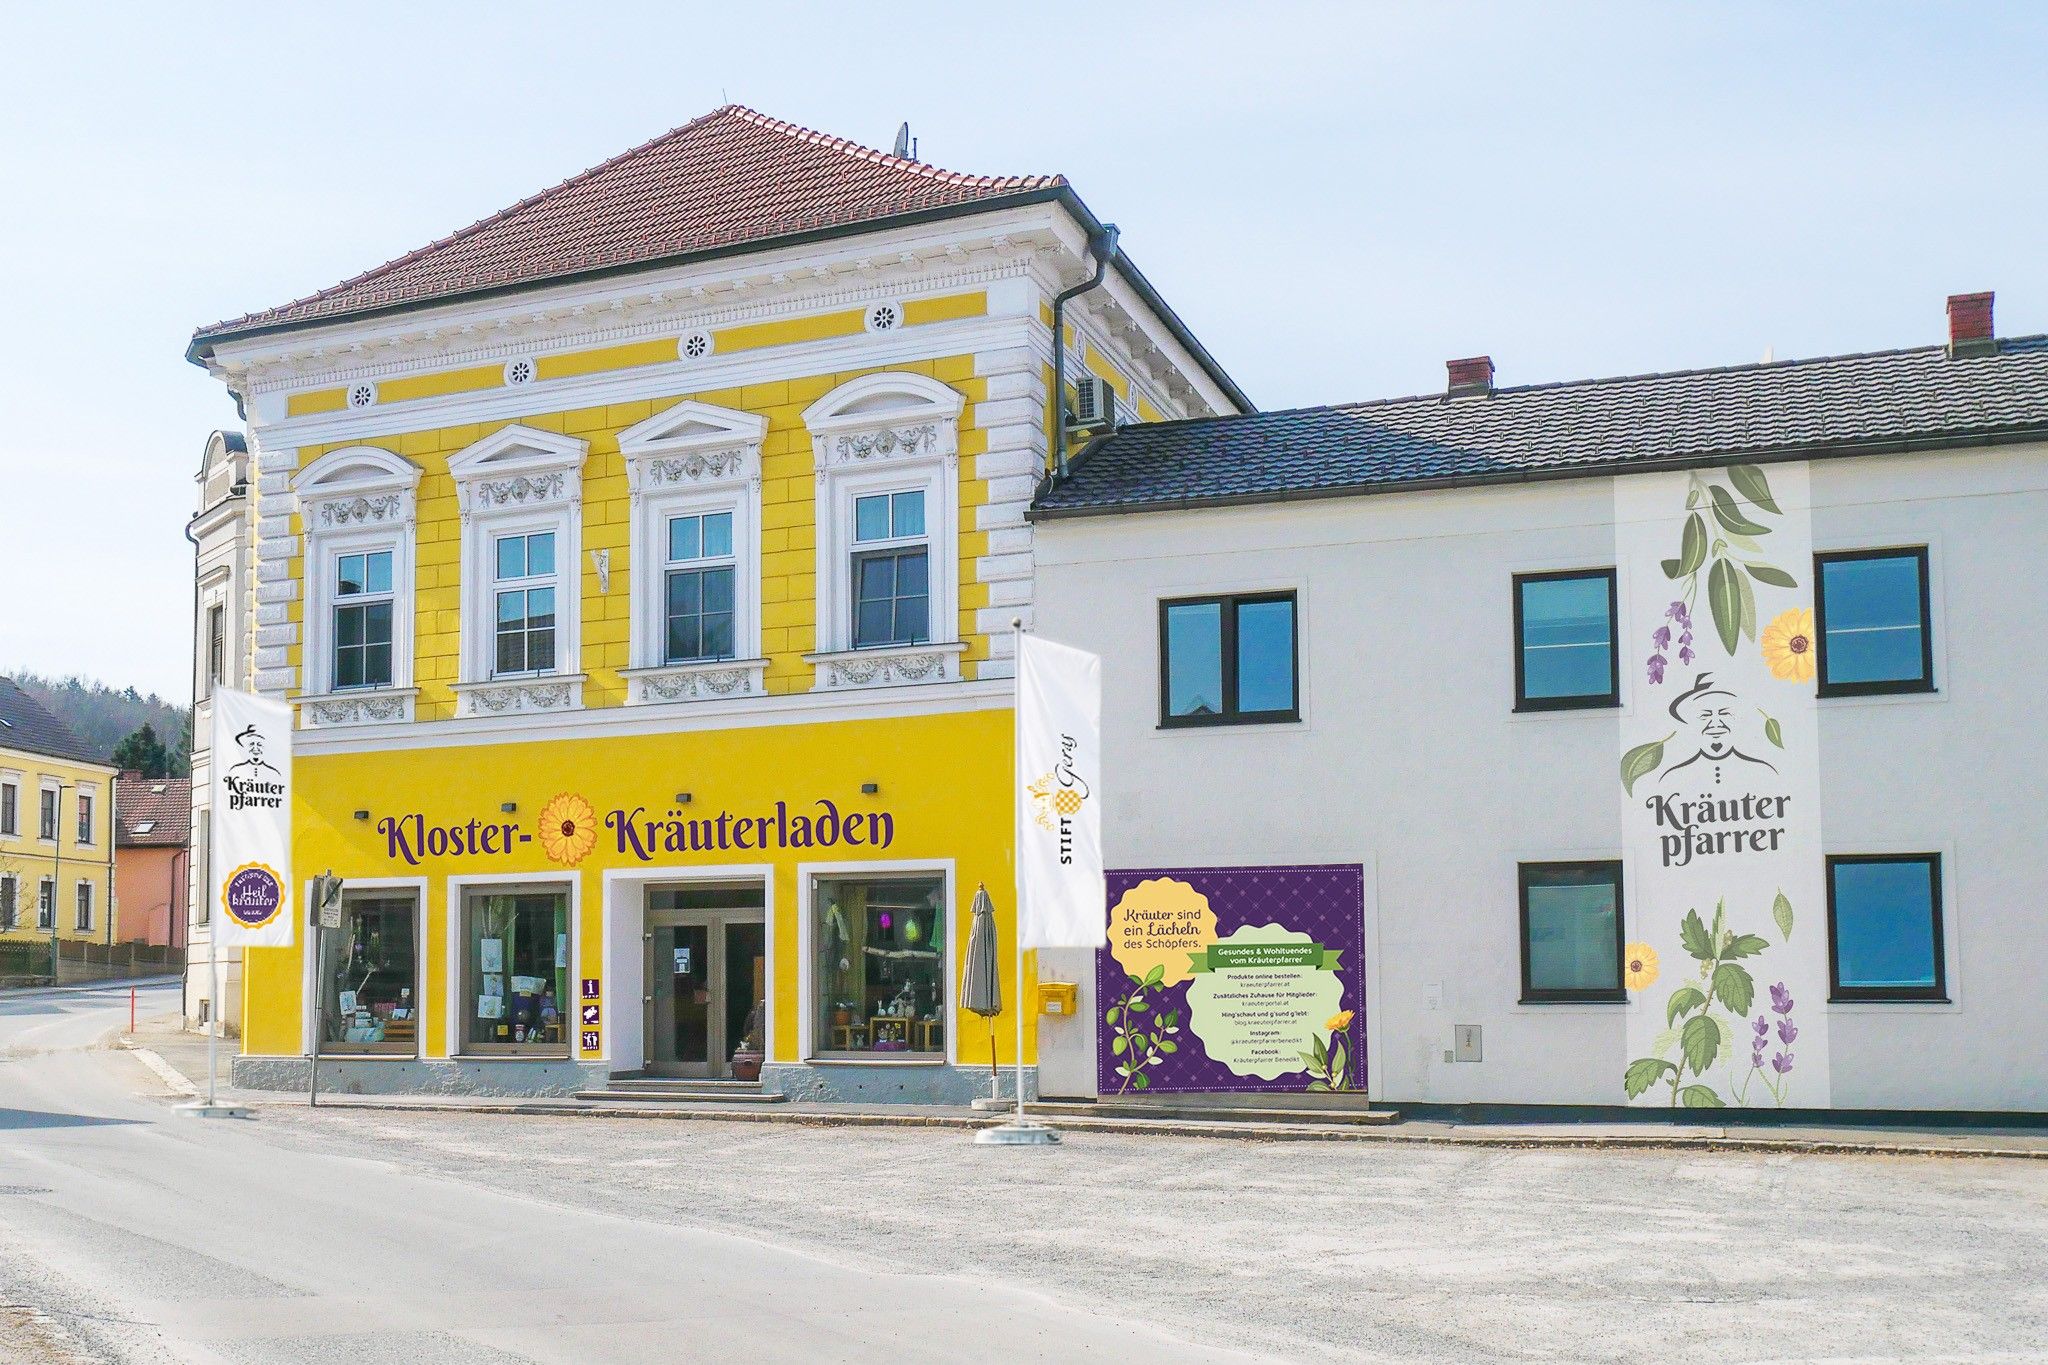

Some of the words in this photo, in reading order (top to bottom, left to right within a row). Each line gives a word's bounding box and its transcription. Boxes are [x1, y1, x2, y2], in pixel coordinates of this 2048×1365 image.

[223, 776, 285, 795] Kräuter
[229, 791, 282, 811] pfarrer
[1645, 792, 1791, 831] Kräuter
[377, 813, 533, 866] Kloster-
[604, 799, 895, 862] Kräuterladen
[1060, 817, 1072, 865] STIFT
[1660, 824, 1785, 867] pfarrer
[1123, 908, 1174, 923] Kräuter
[1177, 909, 1201, 920] sind
[1123, 925, 1143, 936] ein
[1146, 921, 1201, 937] Lächeln
[1123, 940, 1143, 949] des
[1145, 938, 1202, 950] Schöpfers.
[1217, 948, 1255, 956] Gesundes
[1263, 947, 1313, 955] Wohltuendes
[1247, 956, 1303, 965] Kräuterpfarrer
